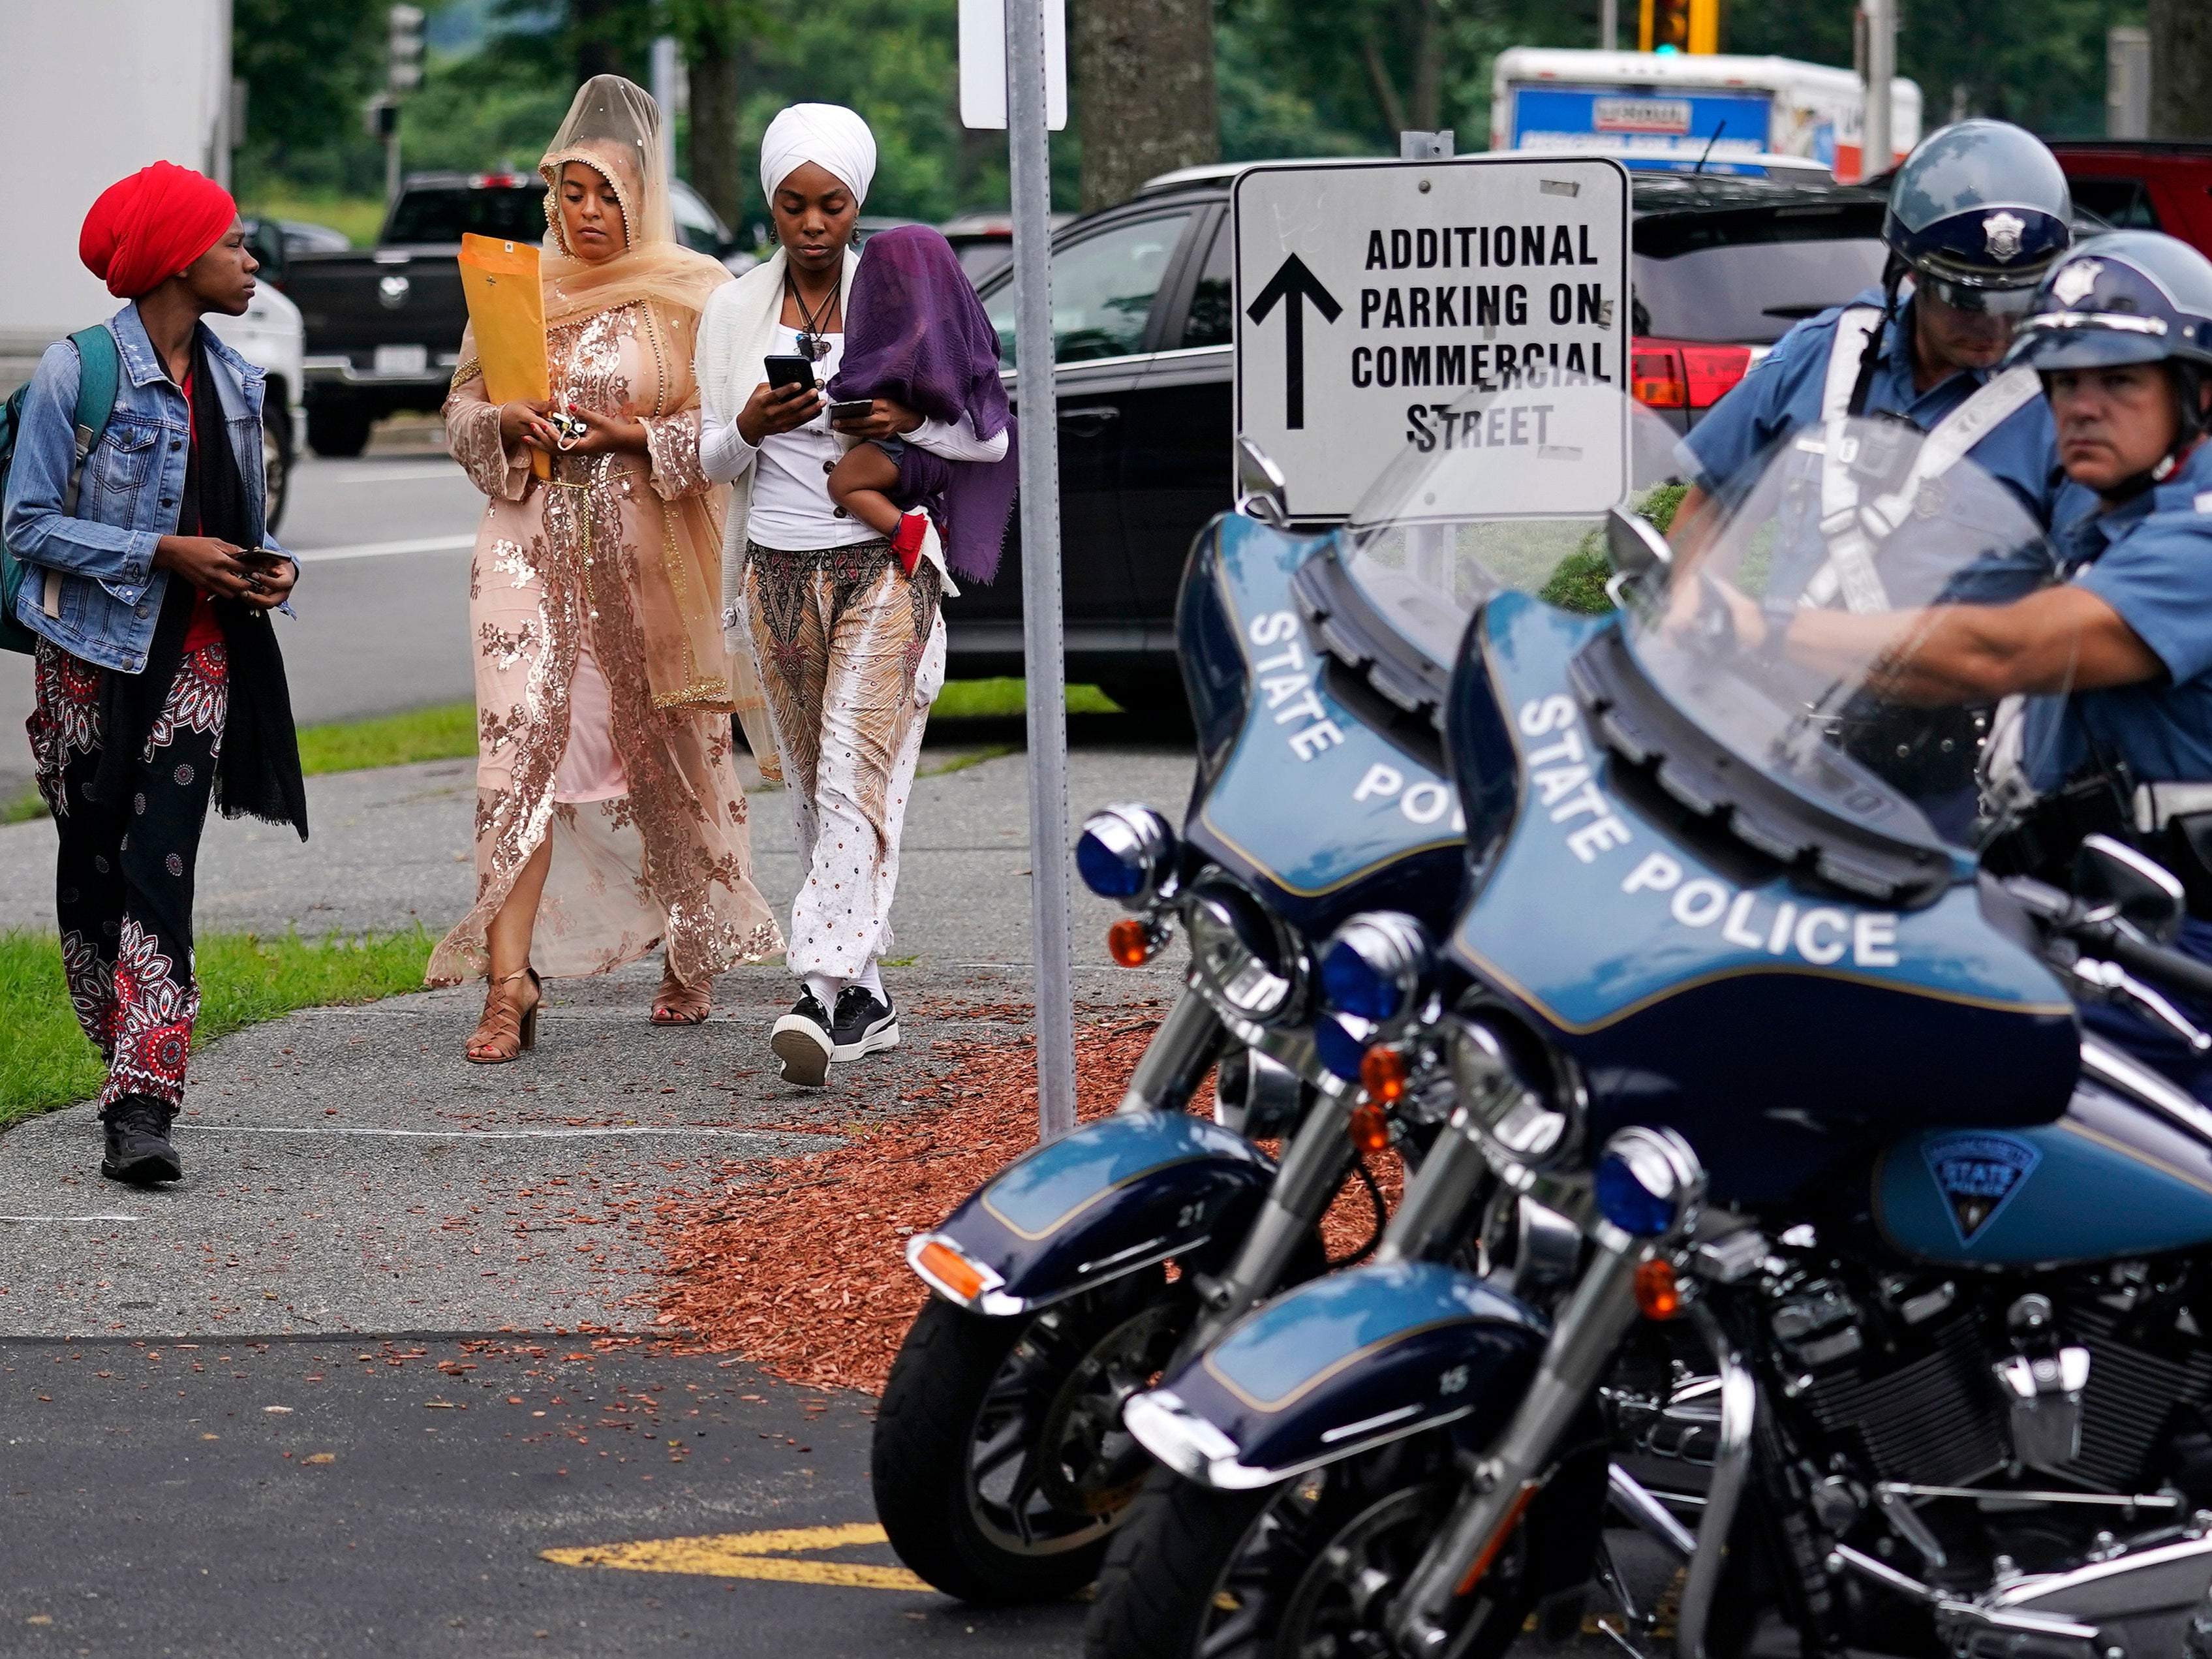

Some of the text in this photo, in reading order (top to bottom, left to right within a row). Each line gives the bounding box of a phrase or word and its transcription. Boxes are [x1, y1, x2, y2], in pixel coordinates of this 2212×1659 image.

[1364, 225, 1599, 271] ADDITIONAL
[1360, 283, 1602, 330] PARKING ON
[1351, 342, 1612, 392] COMMERCIAL
[1406, 404, 1554, 453] STREET
[1250, 610, 1345, 762] STATE
[1518, 692, 1901, 969] STATE POLICE
[1176, 1200, 1206, 1228] 21
